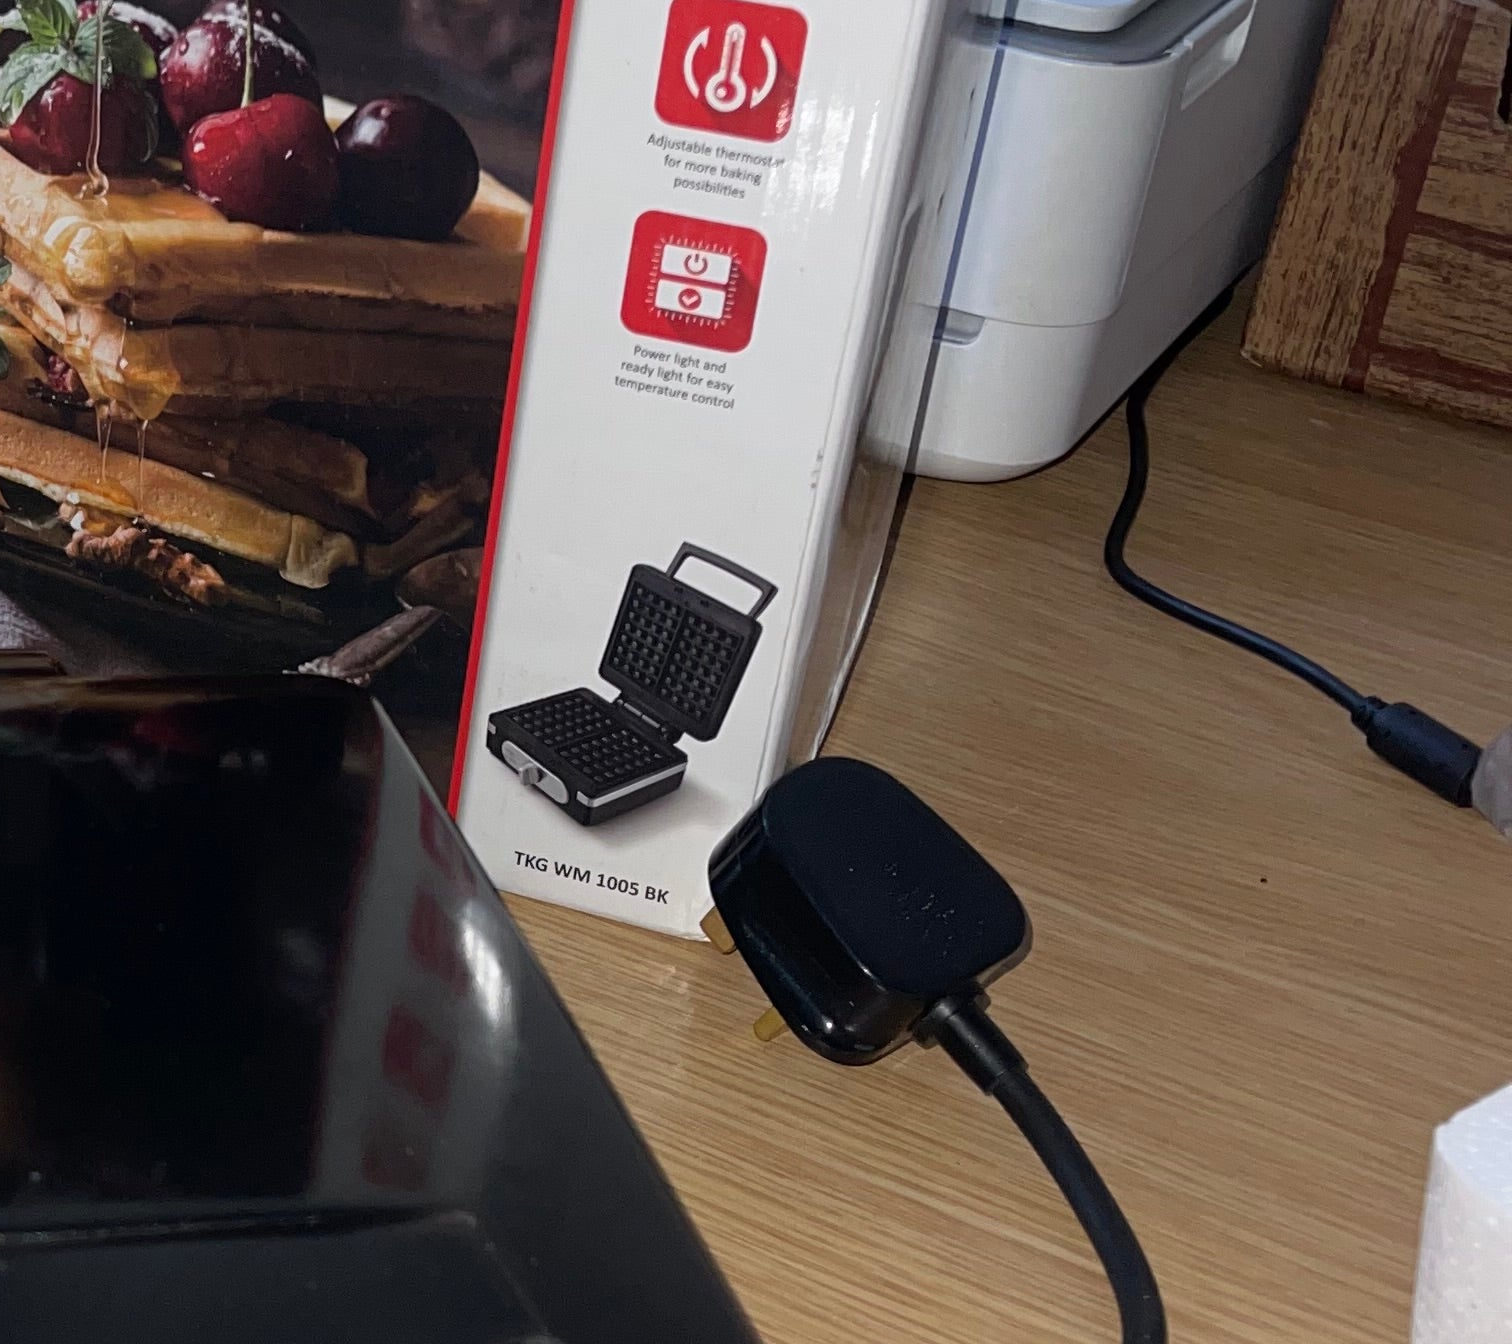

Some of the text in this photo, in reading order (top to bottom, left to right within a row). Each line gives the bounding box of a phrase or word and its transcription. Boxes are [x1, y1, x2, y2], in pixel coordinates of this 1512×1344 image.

[647, 133, 712, 157] Adjustable
[664, 155, 762, 187] for more baking
[673, 176, 746, 200] possibilities
[633, 345, 728, 374] Power light and
[614, 376, 736, 410] temperature control
[620, 361, 734, 395] ready light for easy
[514, 850, 670, 905] TKG WM 1005 BK
